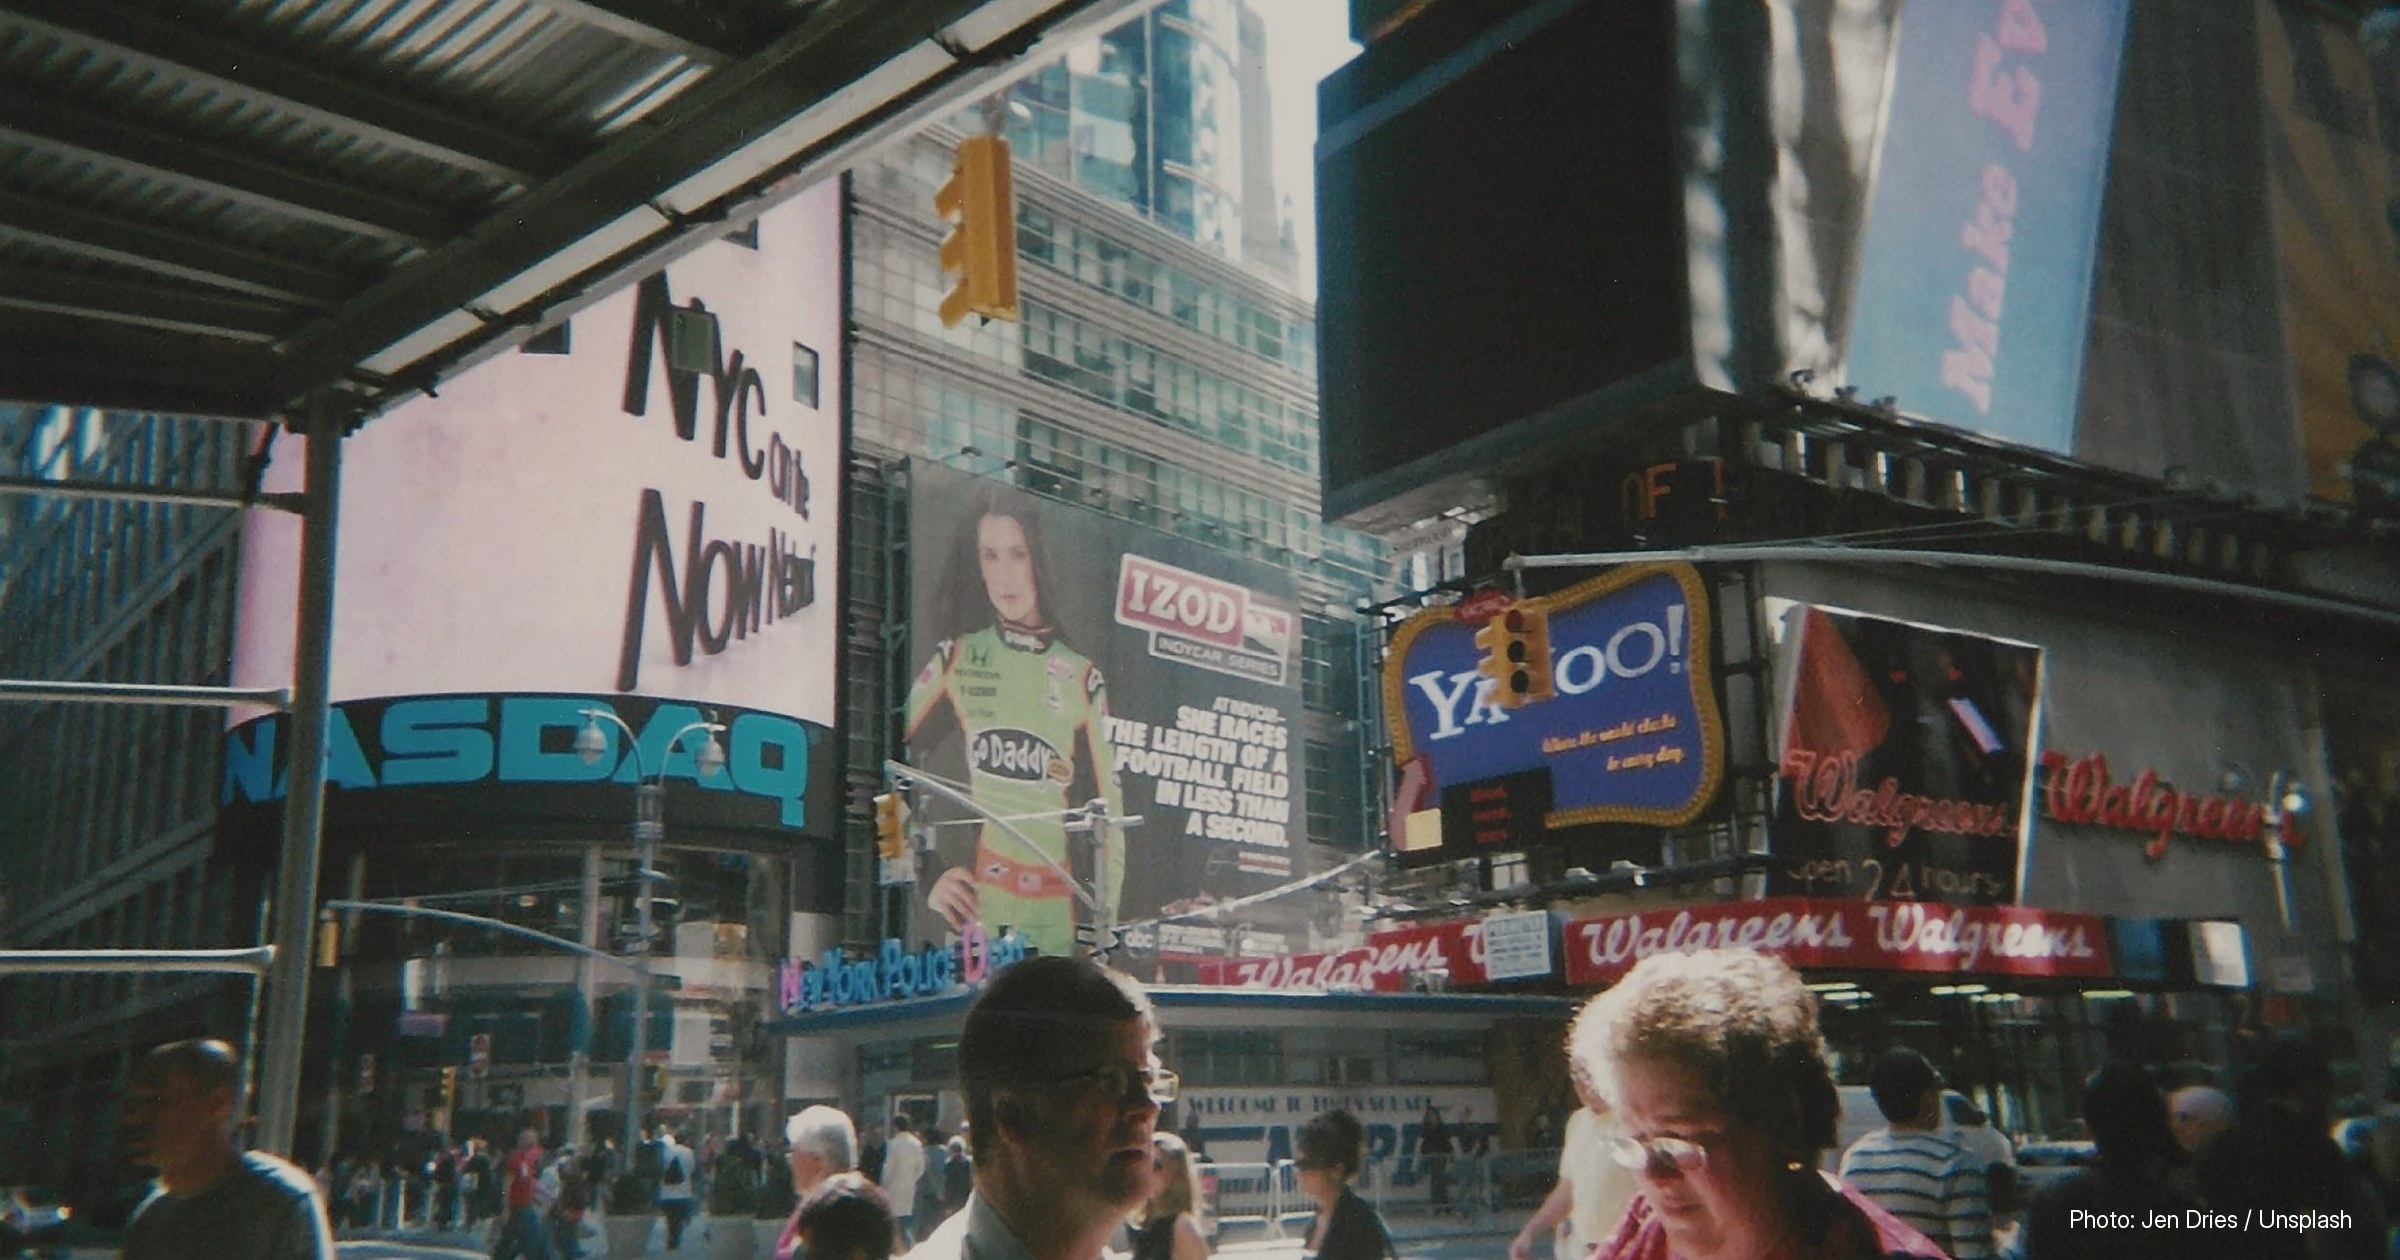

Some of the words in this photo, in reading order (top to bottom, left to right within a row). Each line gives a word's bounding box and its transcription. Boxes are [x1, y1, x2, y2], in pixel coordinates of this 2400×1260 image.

[1940, 163, 2017, 415] Make
[620, 268, 766, 480] NYC
[1127, 568, 1238, 635] IZOD
[1408, 602, 1687, 741] YAOO!
[1103, 715, 1148, 748] THE
[1151, 725, 1238, 765] LENGTH
[1240, 743, 1270, 770] OF
[1271, 750, 1288, 775] A
[1176, 705, 1218, 736] SHE
[1219, 714, 1288, 750] RACES
[222, 697, 809, 828] NASDAQ
[990, 733, 1051, 793] Daddy
[1115, 745, 1228, 788] FOOTBALL
[1232, 766, 1289, 799] FIELD
[1154, 778, 1182, 807] IN
[1182, 782, 1234, 815] LESS
[1235, 792, 1290, 824] THAN
[1185, 810, 1204, 837] A
[1204, 813, 1289, 849] SECOND.
[1786, 750, 2018, 848] Walgreens
[1125, 930, 1154, 948] abc
[1582, 910, 1853, 968] Walgreens
[1868, 904, 2093, 972] Walgreens
